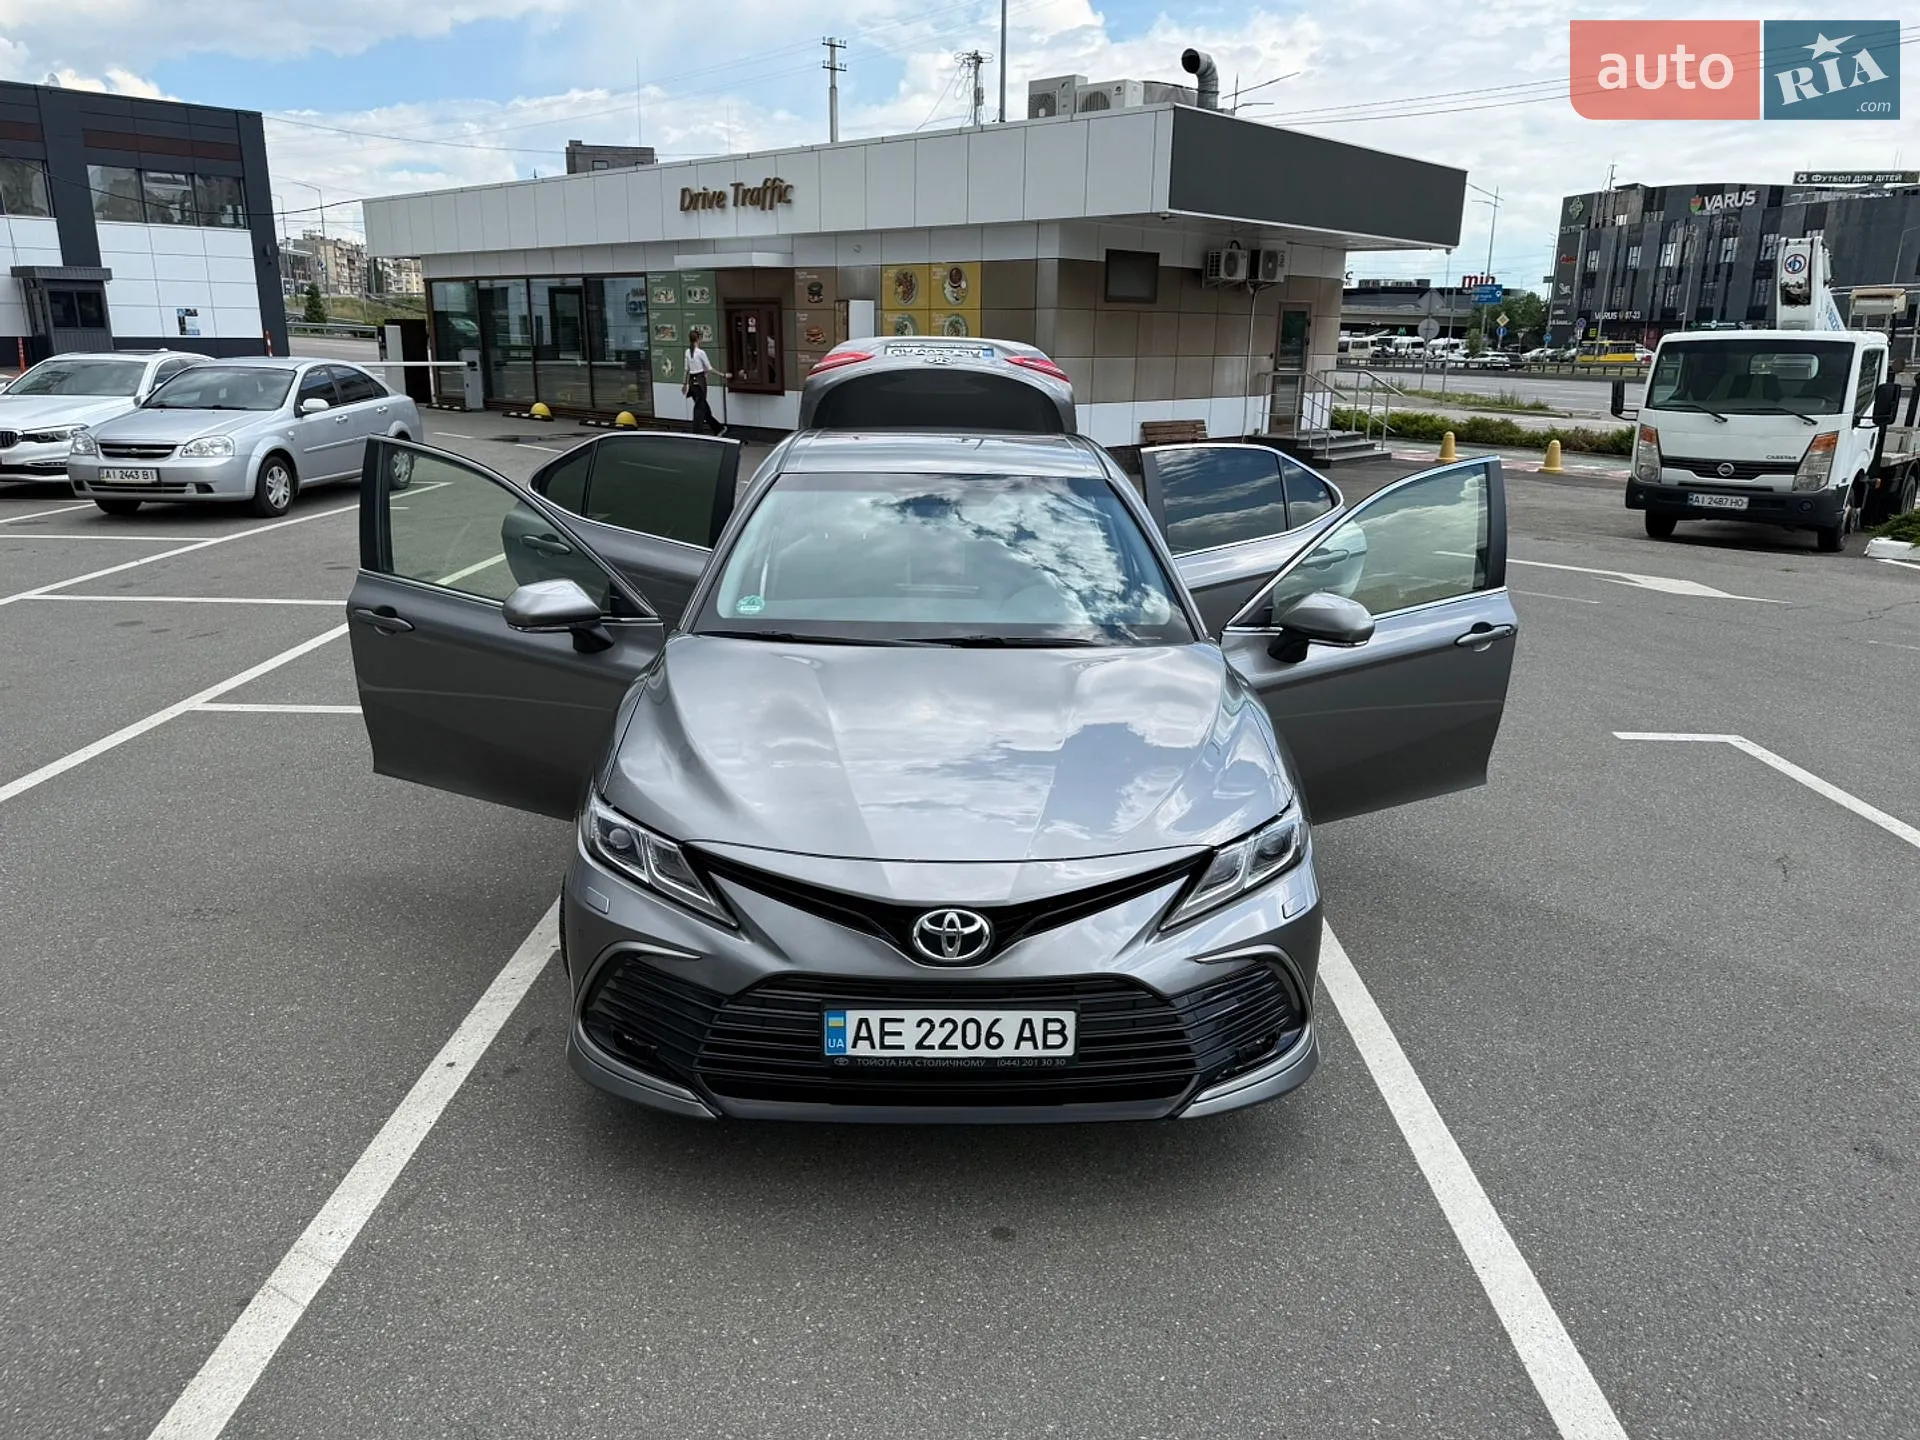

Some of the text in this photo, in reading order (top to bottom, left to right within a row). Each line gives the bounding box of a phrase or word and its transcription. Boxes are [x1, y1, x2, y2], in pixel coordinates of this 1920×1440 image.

[1811, 173, 1902, 182] ФУТБОЛ ДЛЯ ДІТЕЙ
[680, 177, 794, 211] Drive Traffic
[1704, 190, 1756, 210] VARUS
[1708, 496, 1729, 506] 2487
[851, 1017, 1068, 1051] AE 2206 AB
[828, 1038, 845, 1049] UA
[857, 1057, 896, 1067] ТОЙОТА
[899, 1058, 912, 1067] НА
[915, 1057, 986, 1068] СТОЛИЧНОМУ
[1022, 1058, 1038, 1067] 201
